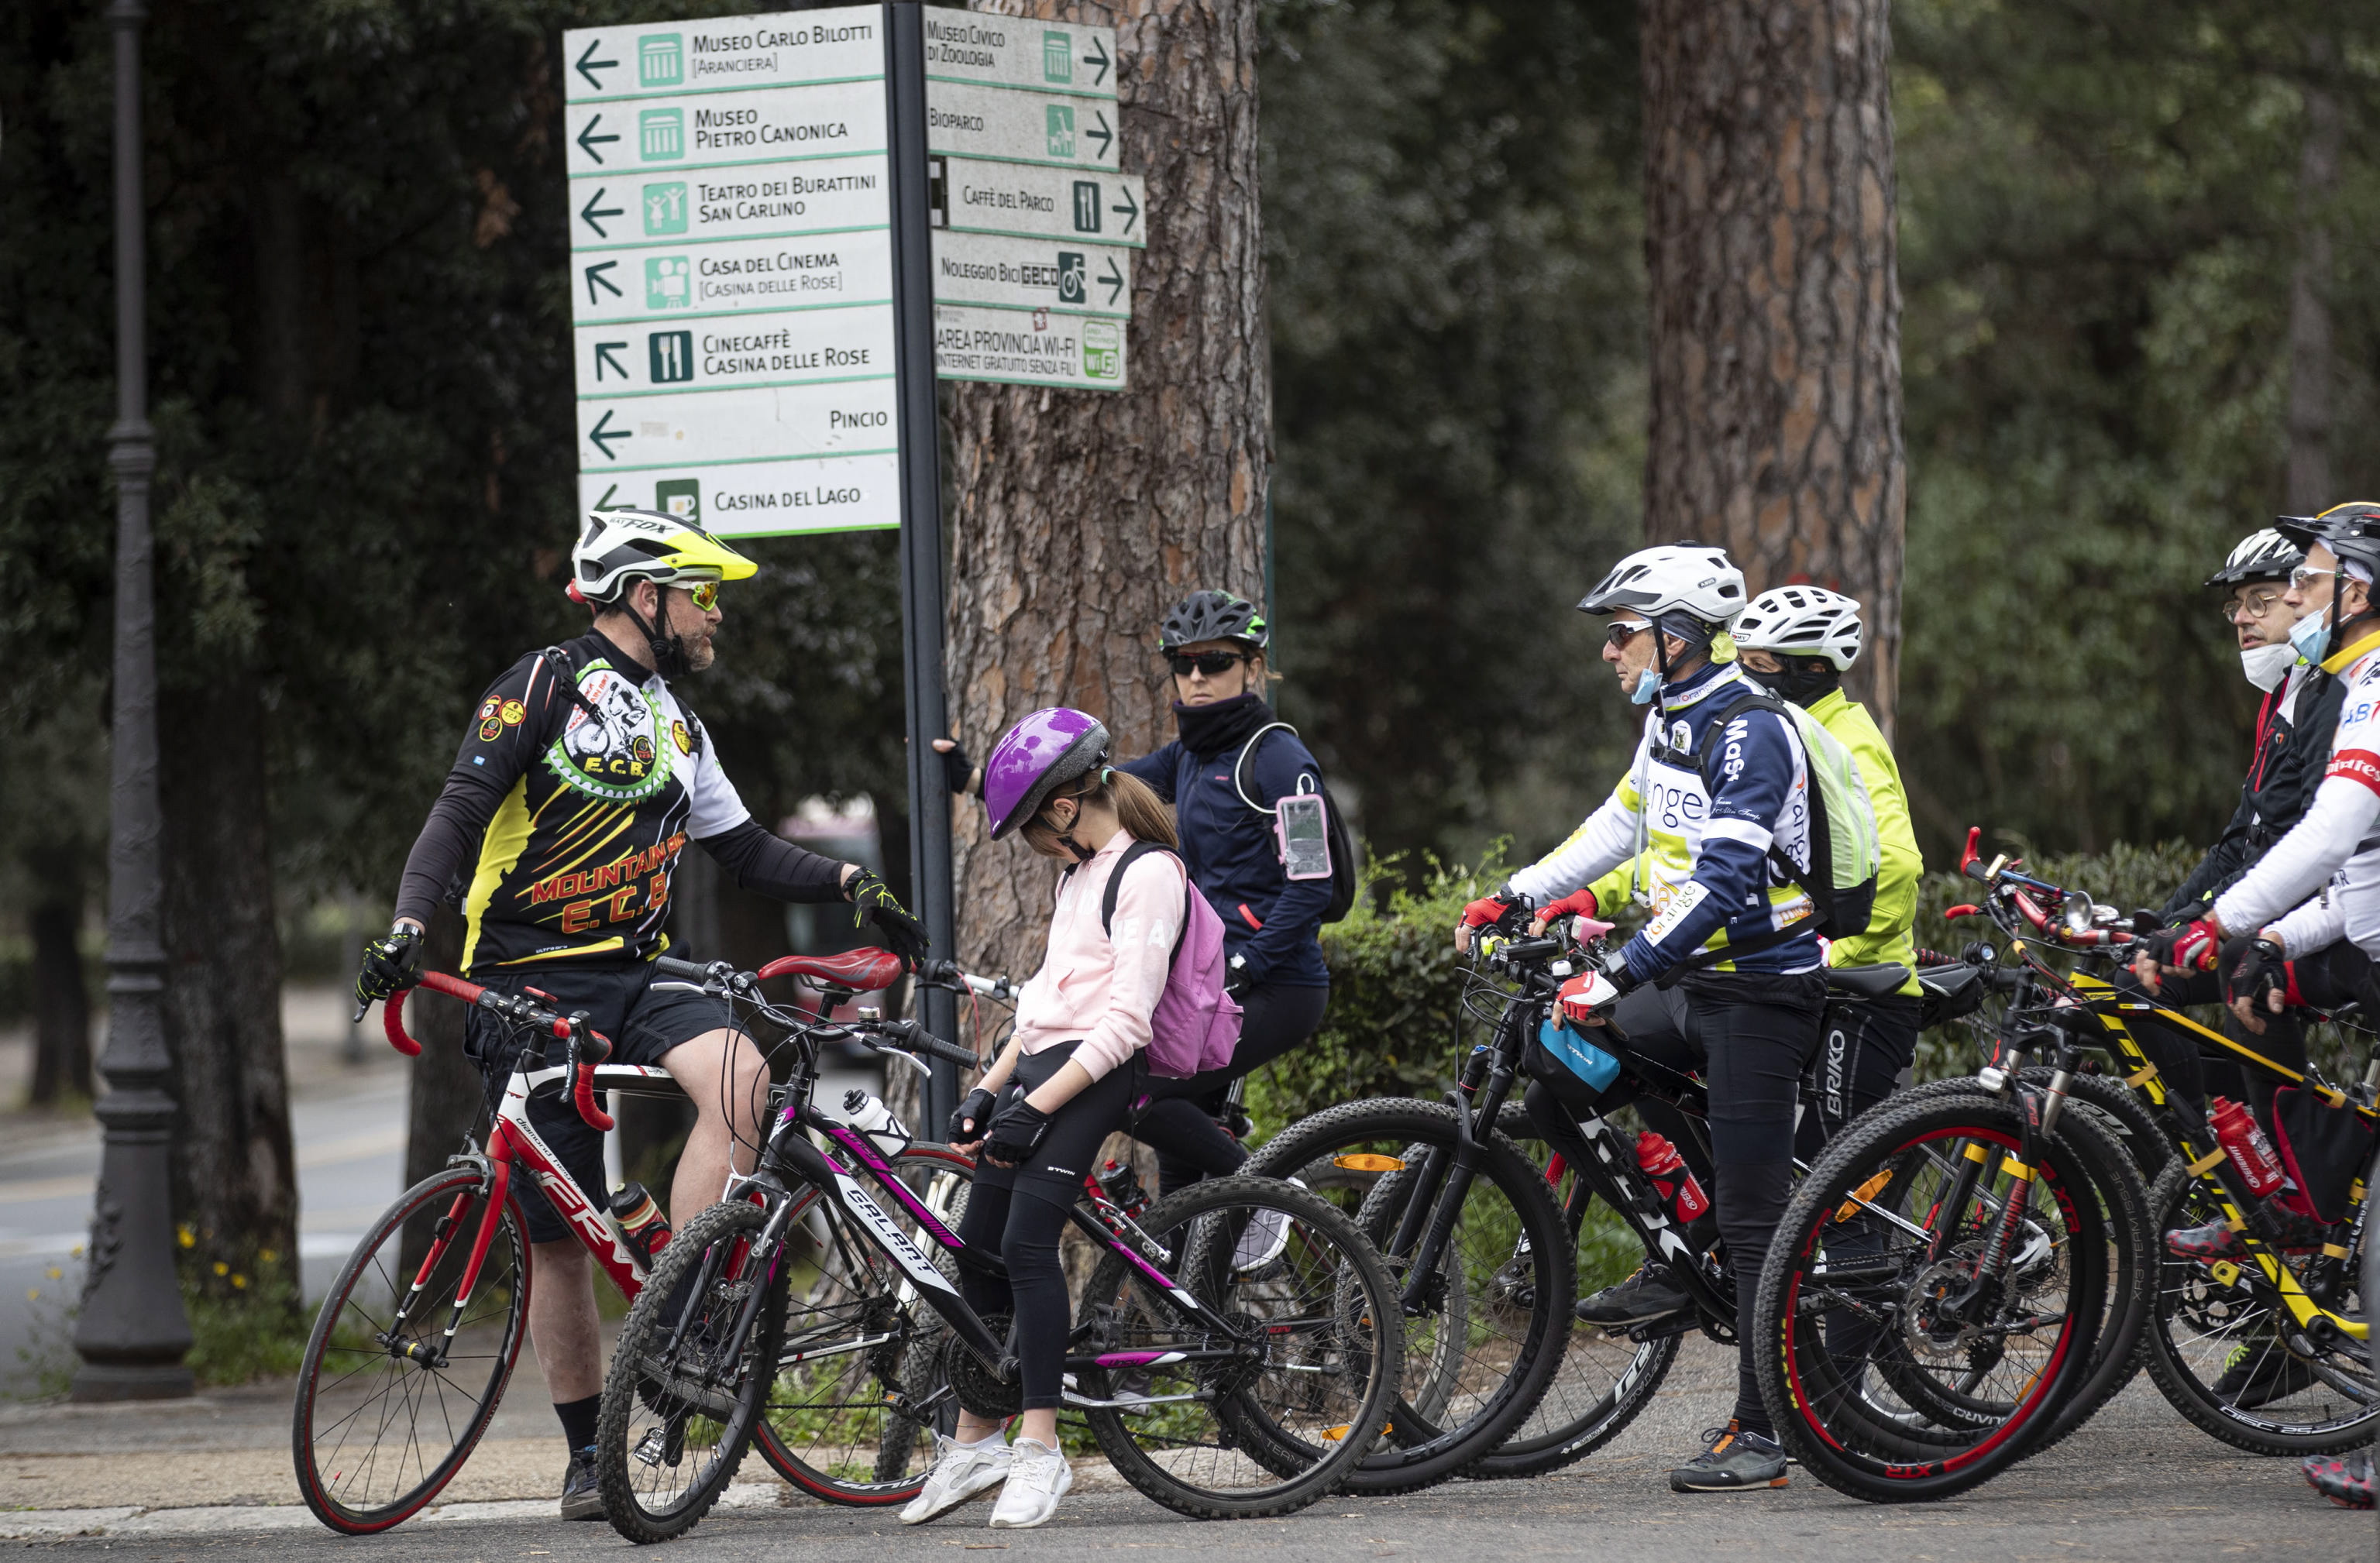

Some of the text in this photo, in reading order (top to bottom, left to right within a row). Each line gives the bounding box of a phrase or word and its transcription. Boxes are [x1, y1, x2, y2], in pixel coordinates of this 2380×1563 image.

[693, 25, 873, 54] MUSEO CARLO BILOTTI
[927, 21, 1006, 48] MUSEO CIVICO
[928, 43, 996, 67] DI ZOOLOGIA
[696, 108, 758, 129] MUSEO
[930, 108, 984, 132] BIOPARCO
[696, 122, 848, 149] PIETRO CANONICA
[698, 174, 877, 202] TEATRO DEI BURATTINI
[964, 186, 1054, 212] CAFFÈ DEL PARCO
[700, 201, 806, 224] SAN CARLINO
[700, 252, 840, 277] CASA DEL CINEMA
[941, 257, 997, 281] NOLEGGIO
[999, 263, 1020, 283] BICI
[758, 279, 797, 294] DELLE
[703, 328, 791, 355] CINECAFFÈ
[937, 329, 1076, 358] AREA PROVINCIA WI-FI
[703, 348, 870, 375] CASINA DELLE ROSE
[937, 353, 1076, 376] INTERNET GRATUITO SENZA FILI
[830, 410, 888, 429] PINCIO
[714, 486, 862, 512] CASINA DEL LAGO
[622, 519, 675, 534] FOX
[1653, 782, 1704, 828] nge
[531, 842, 666, 905] MOUNTAIN
[1827, 1029, 1845, 1120] BRIKO
[848, 1190, 937, 1274] GALANT
